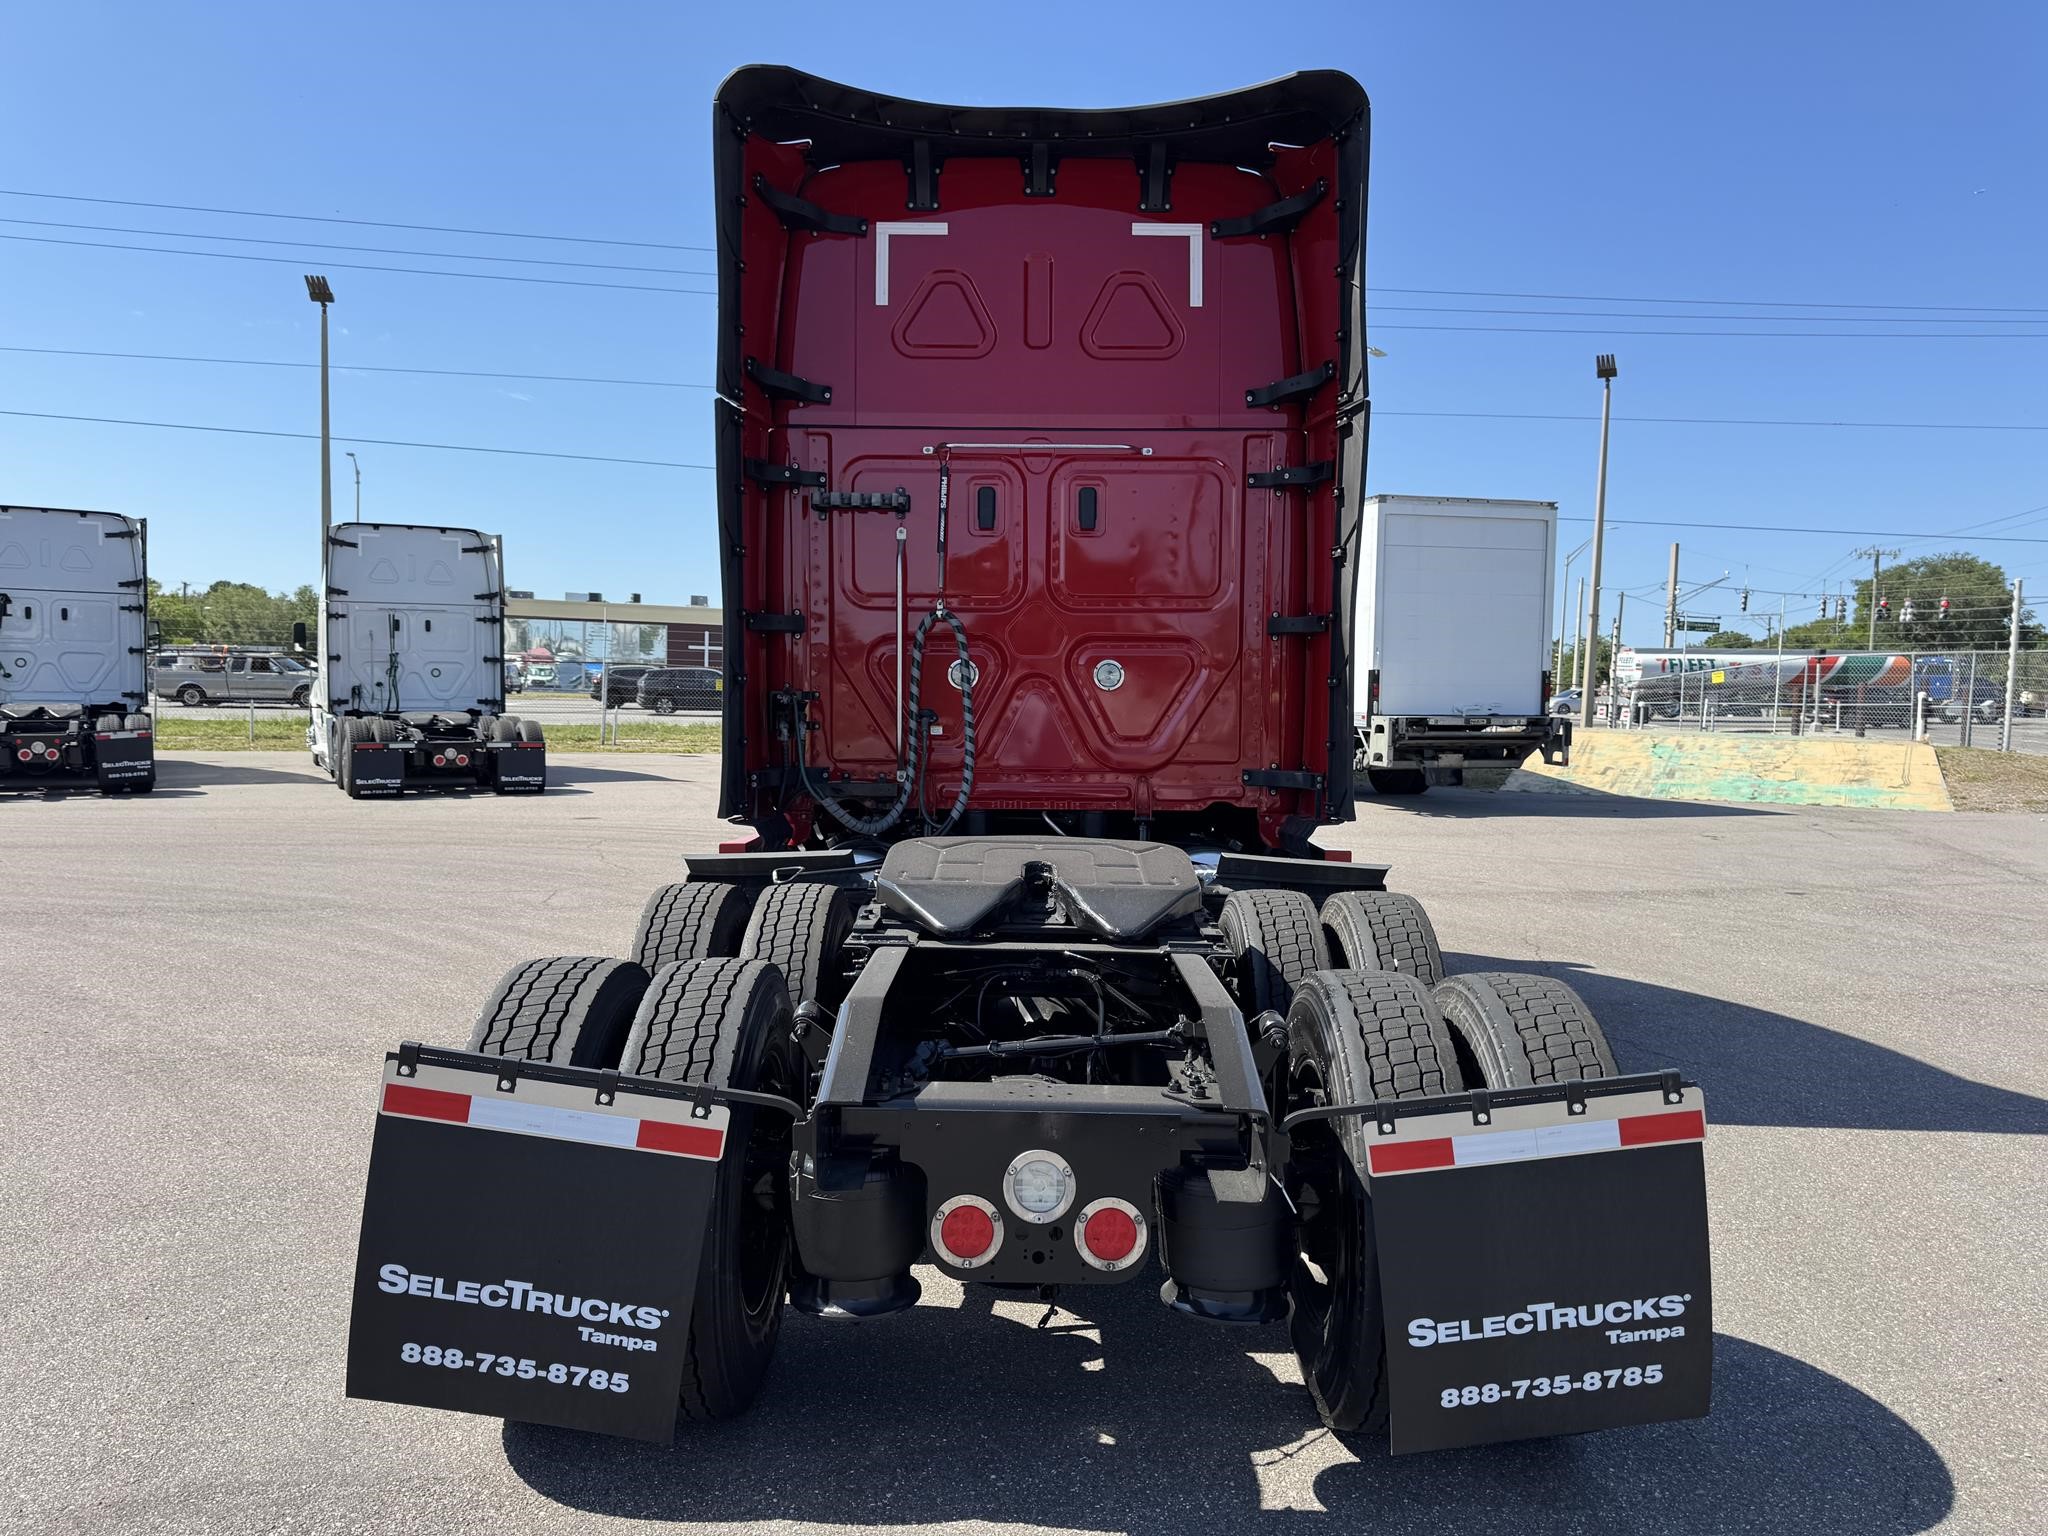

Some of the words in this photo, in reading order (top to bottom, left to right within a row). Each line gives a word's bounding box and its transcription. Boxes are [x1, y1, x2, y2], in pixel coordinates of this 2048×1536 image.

[577, 1326, 658, 1352] Tampa
[1605, 1325, 1686, 1345] Tampa
[400, 1342, 630, 1394] 888-735-8785
[1440, 1364, 1664, 1409] 888-735-8785
